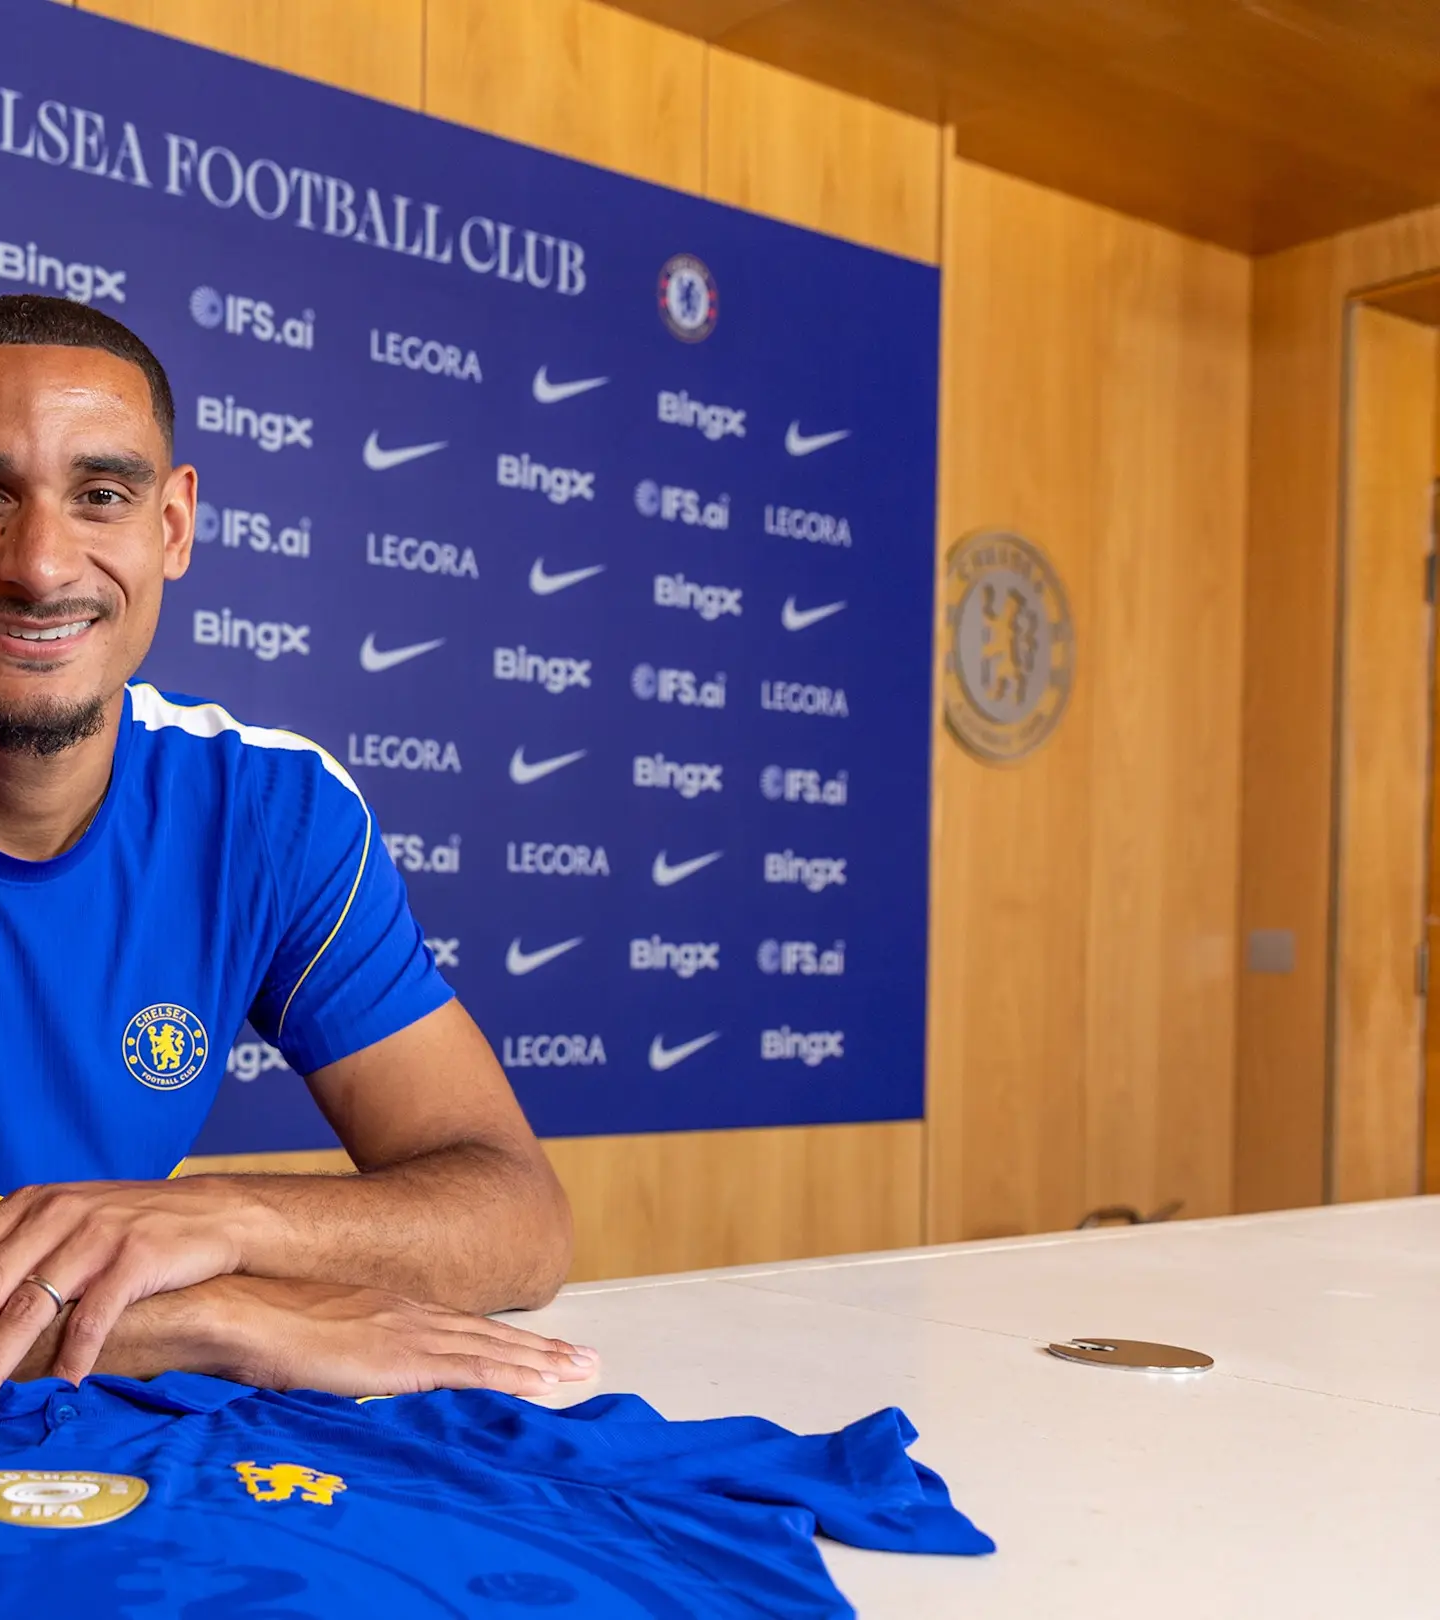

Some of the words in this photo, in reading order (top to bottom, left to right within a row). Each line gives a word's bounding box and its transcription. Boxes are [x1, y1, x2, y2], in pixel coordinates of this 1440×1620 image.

[165, 133, 452, 264] FOOTBALL
[459, 217, 586, 295] CLUB
[225, 294, 314, 350] IFS.ai
[370, 328, 483, 383] LEGORA
[222, 508, 310, 558] IFS.ai
[764, 505, 852, 547] LEGORA
[366, 532, 479, 579] LEGORA
[761, 681, 849, 717] LEGORA
[348, 733, 462, 773] LEGORA
[506, 842, 610, 876] LEGORA
[135, 1007, 188, 1028] CHELSEA
[503, 1034, 607, 1067] LEGORA
[141, 1071, 179, 1086] FOOTBALL
[179, 1065, 196, 1081] CLUB
[10, 1504, 84, 1519] FIFA
